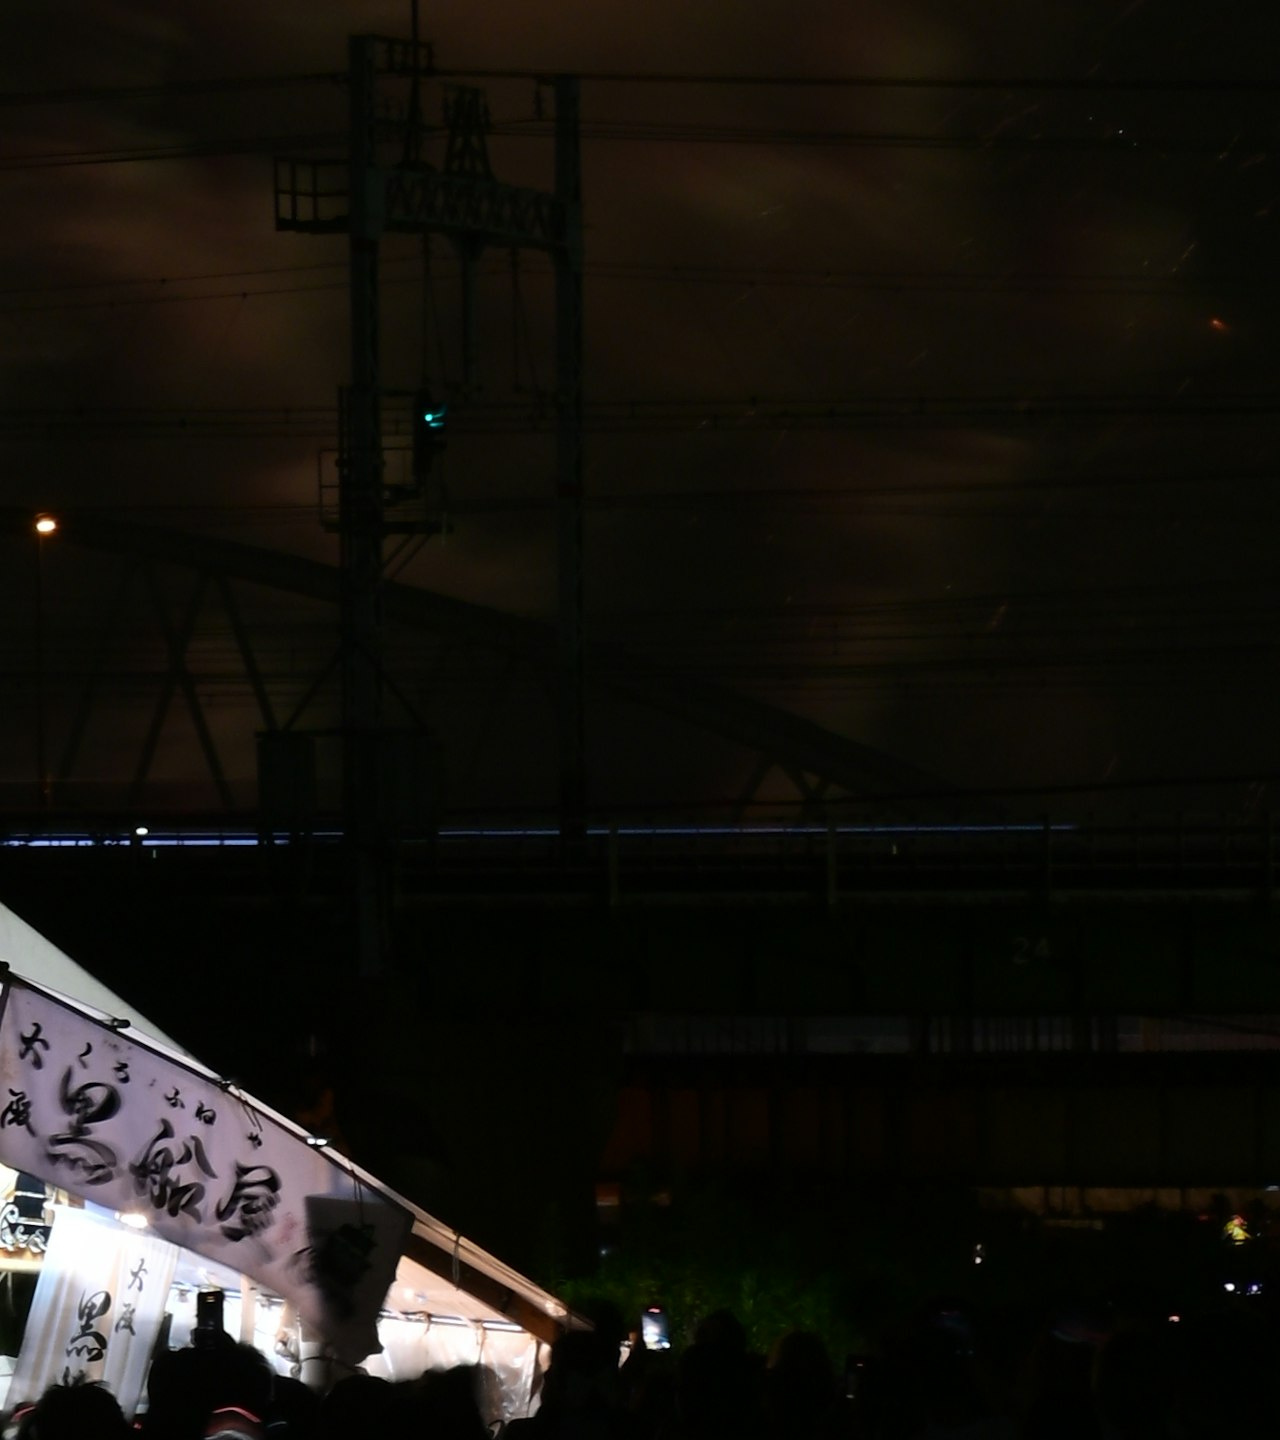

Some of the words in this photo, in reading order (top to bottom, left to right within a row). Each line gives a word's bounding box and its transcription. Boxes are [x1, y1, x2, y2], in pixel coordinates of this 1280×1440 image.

[1011, 937, 1052, 965] 24
[46, 1066, 282, 1242] 黒船屋
[62, 1289, 112, 1386] 黒
